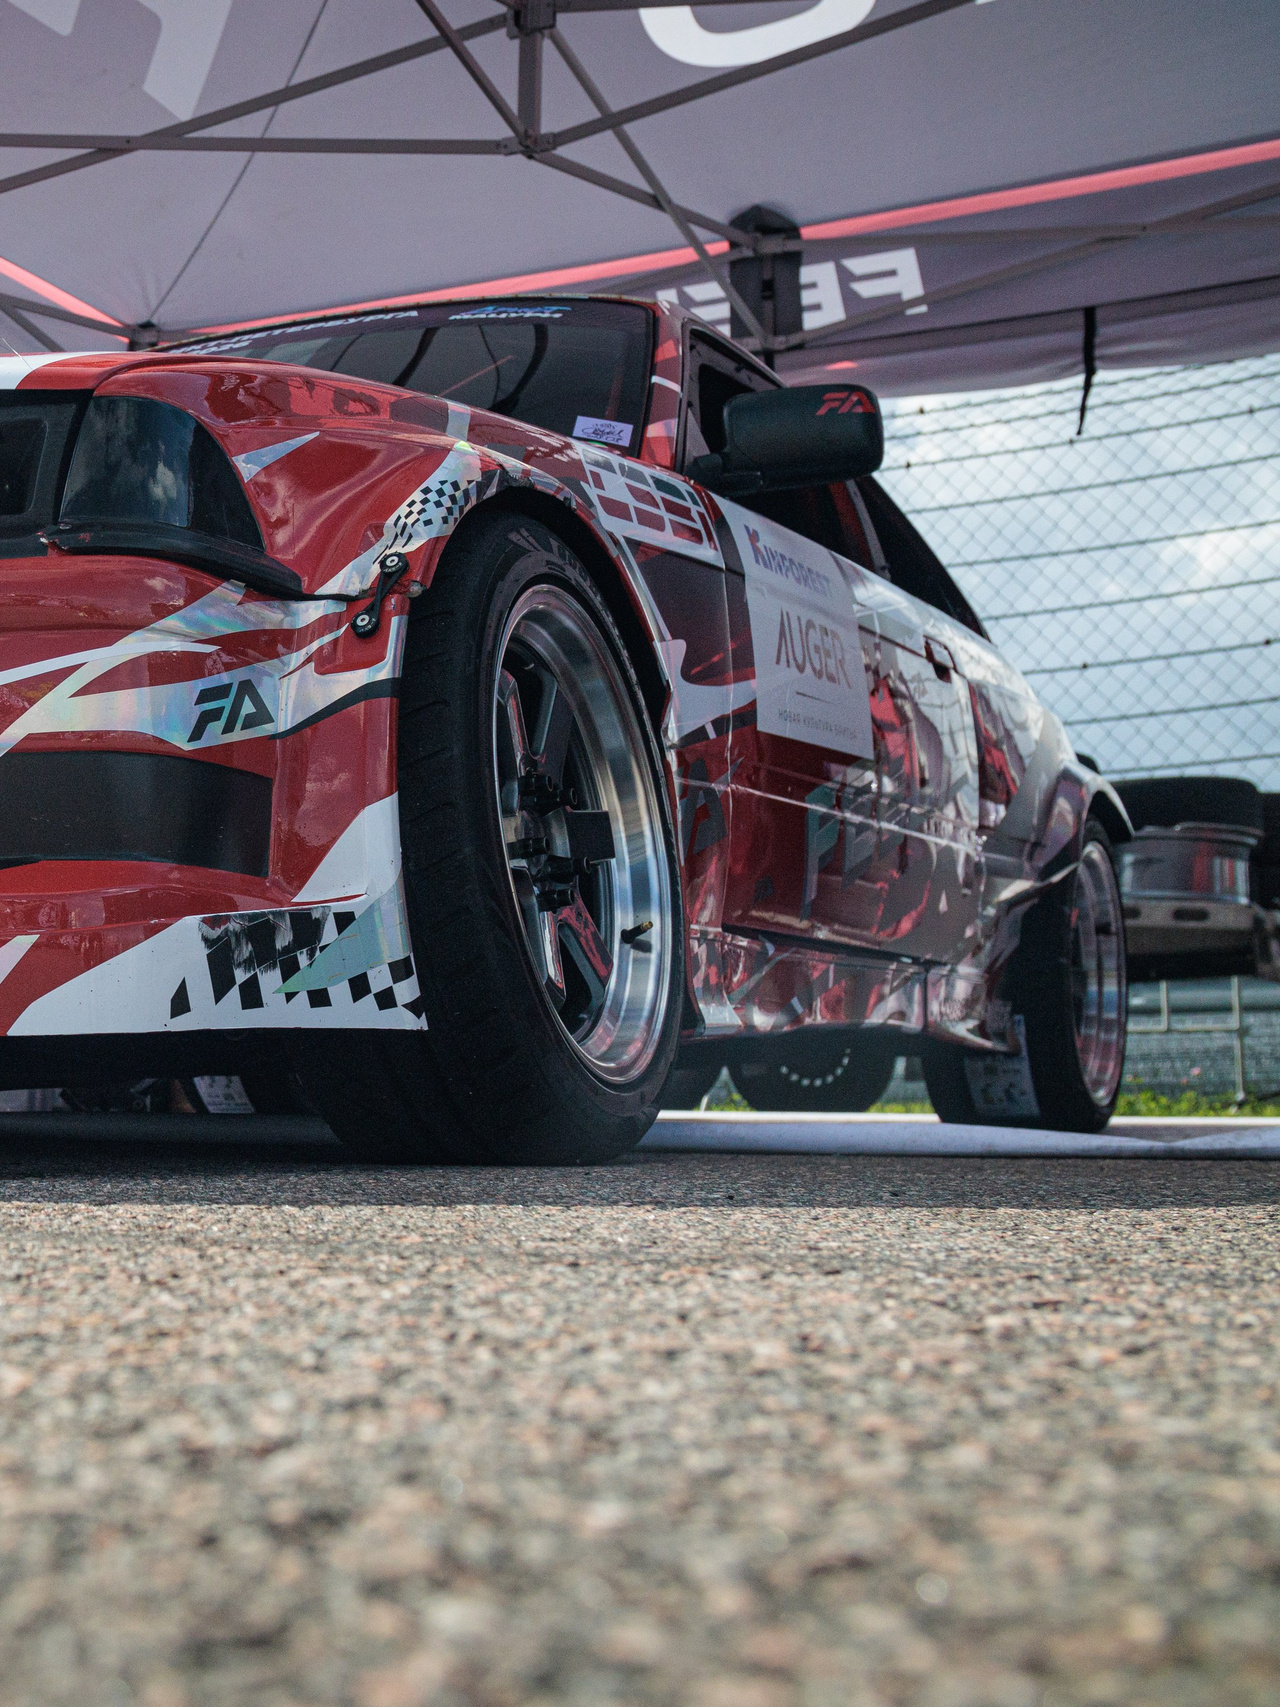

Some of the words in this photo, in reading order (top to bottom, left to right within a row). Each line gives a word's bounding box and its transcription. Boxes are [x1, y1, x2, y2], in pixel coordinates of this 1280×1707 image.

[816, 391, 876, 415] FA
[775, 606, 853, 690] AUGER
[187, 679, 275, 743] FA
